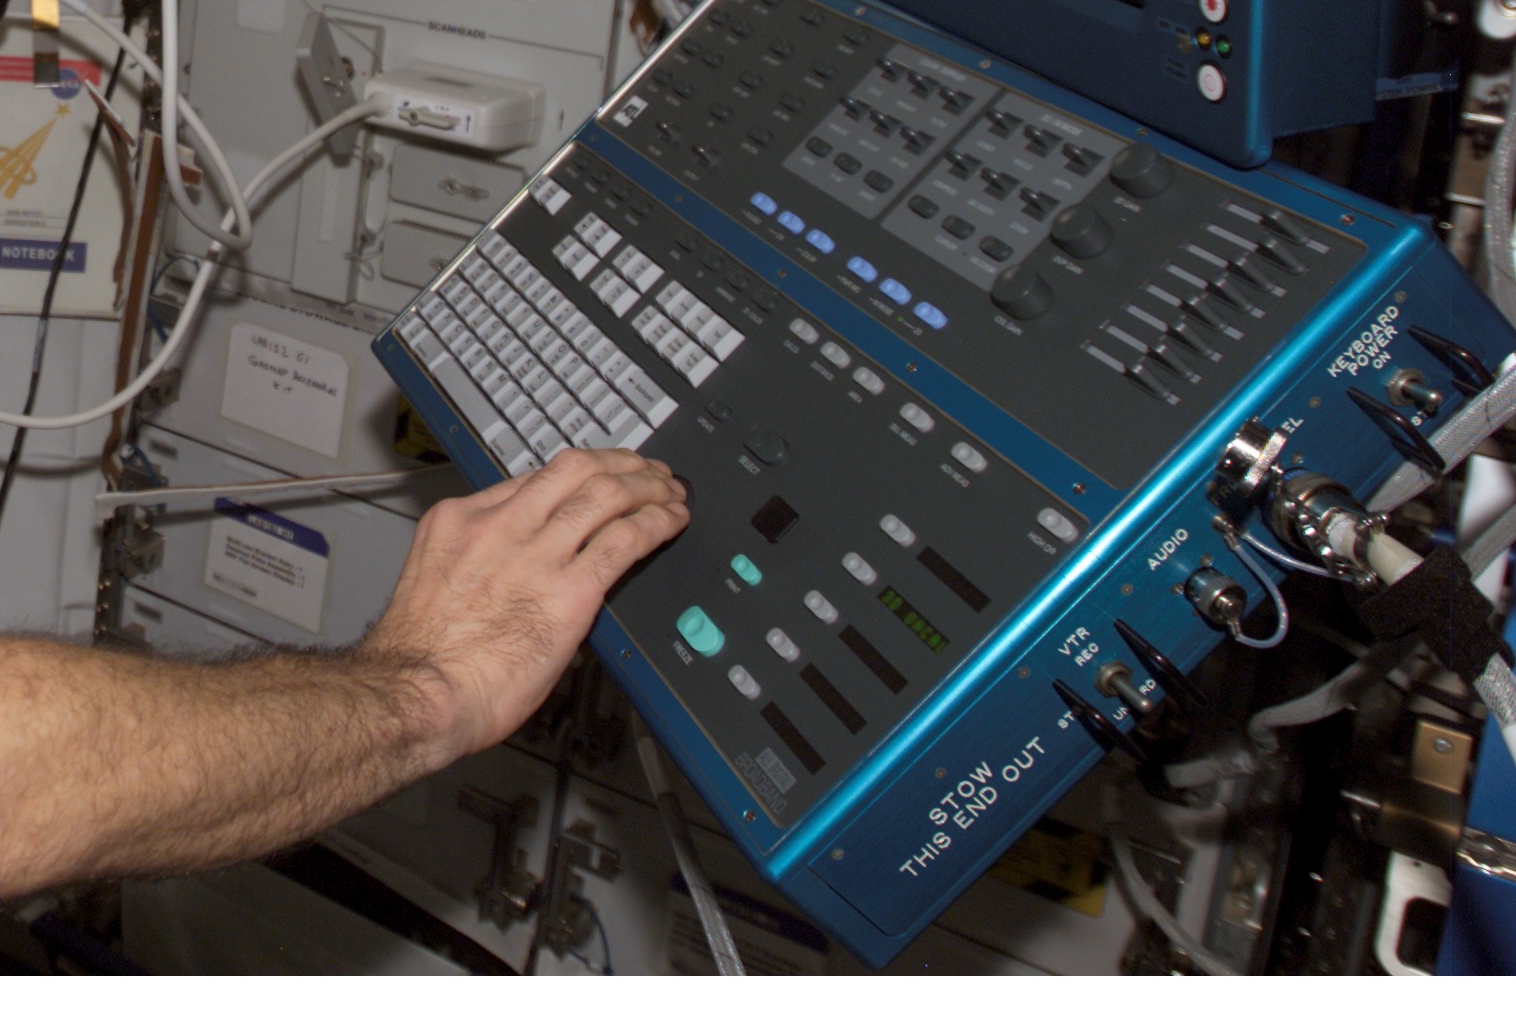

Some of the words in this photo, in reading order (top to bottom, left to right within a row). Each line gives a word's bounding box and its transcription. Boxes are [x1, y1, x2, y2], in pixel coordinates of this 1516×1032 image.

[427, 19, 487, 41] SCANHEADS
[1, 246, 76, 263] NOTEBOK
[1326, 305, 1400, 378] KEYBOARD
[1347, 324, 1399, 377] POWER
[1372, 350, 1392, 370] ON
[738, 455, 761, 476] SELECT
[1026, 530, 1046, 547] HIGH
[1147, 528, 1189, 571] AUDIO
[672, 640, 694, 666] FREEZE
[1057, 626, 1091, 656] VTR
[1074, 643, 1100, 667] REC
[736, 751, 788, 814] BROADBAND
[929, 761, 994, 826] STOW
[899, 831, 952, 877] THIS
[953, 786, 998, 830] END
[1002, 736, 1045, 783] OUT
